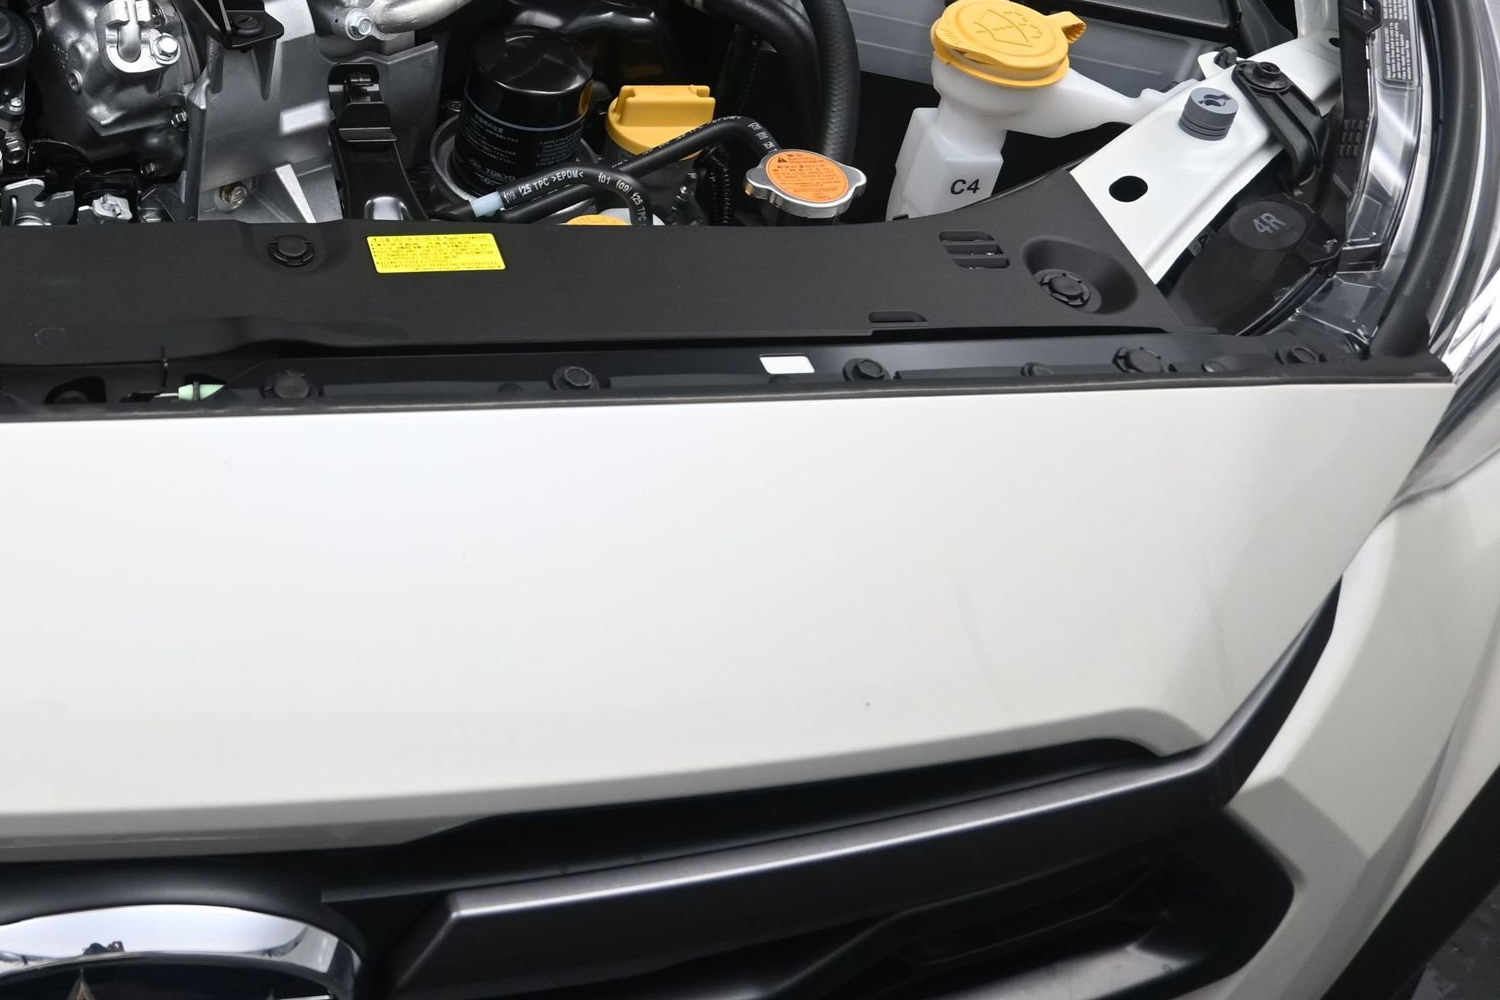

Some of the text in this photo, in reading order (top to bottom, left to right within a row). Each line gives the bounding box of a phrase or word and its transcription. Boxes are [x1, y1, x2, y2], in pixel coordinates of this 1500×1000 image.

[533, 177, 550, 190] TPC
[950, 178, 980, 195] C4
[1253, 212, 1286, 234] 4R
